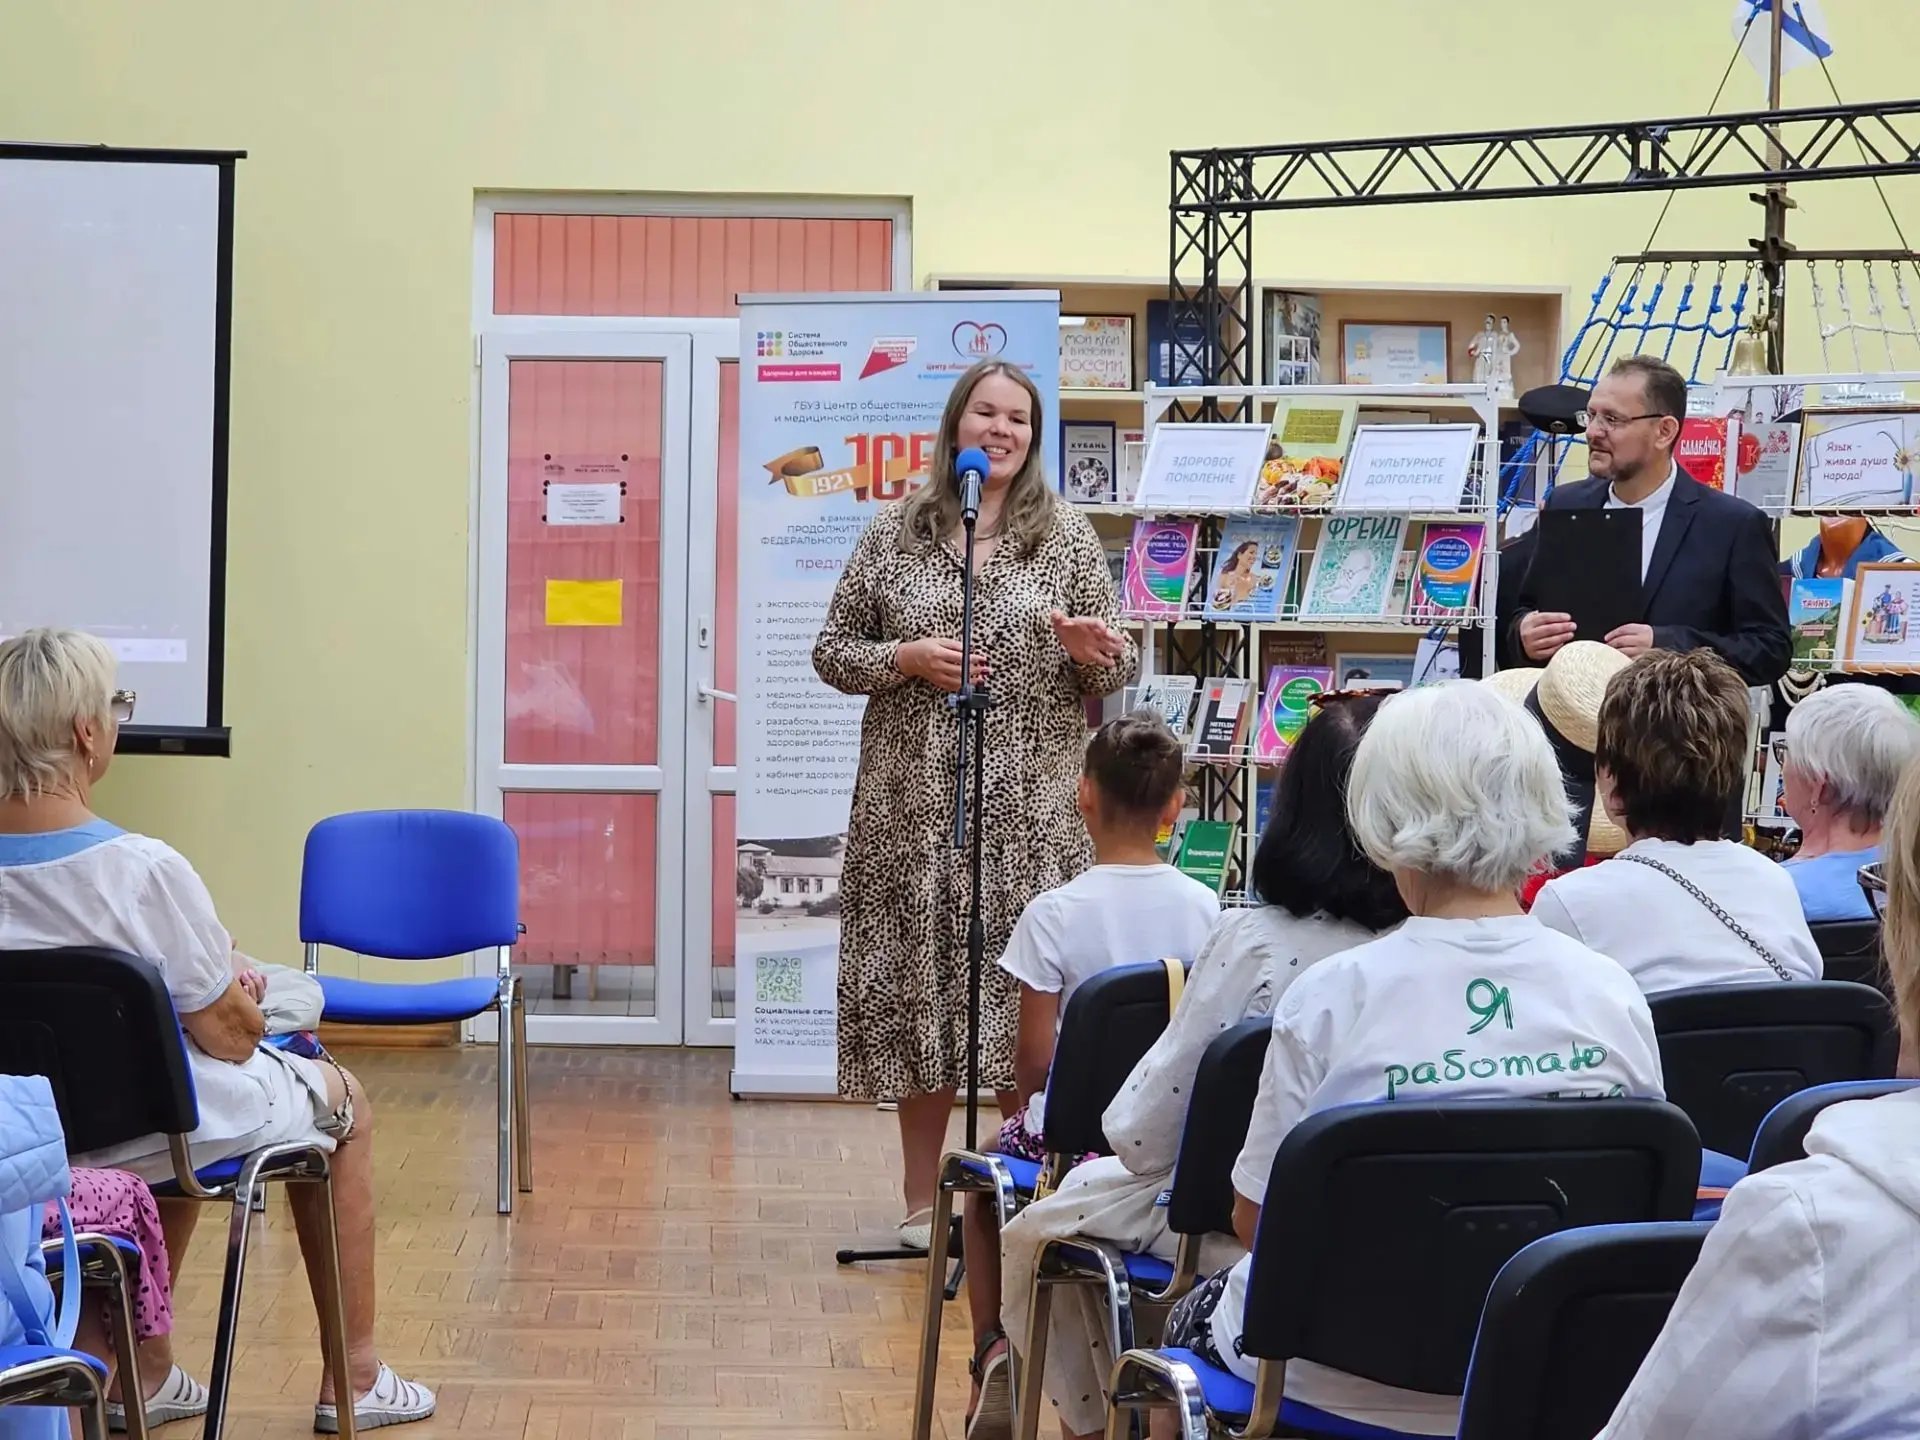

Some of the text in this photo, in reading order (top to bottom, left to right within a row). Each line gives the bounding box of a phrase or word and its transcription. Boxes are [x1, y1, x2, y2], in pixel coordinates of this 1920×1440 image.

[788, 331, 821, 339] Система
[788, 340, 848, 348] Общественного
[788, 348, 824, 357] Здоровья
[794, 401, 821, 410] ГБУЗ
[824, 401, 857, 411] Центр
[774, 415, 782, 423] и
[784, 413, 859, 424] медицинской
[1826, 441, 1852, 452] Язык
[1172, 456, 1236, 468] ЗДОРОВОЕ
[1369, 457, 1446, 468] КУЛЬТУРНОЕ
[1824, 458, 1888, 469] живая душа
[1165, 472, 1237, 484] ПОКОЛЕНИЕ
[1364, 474, 1445, 487] ДОЛГОЛЕТИЕ
[1823, 470, 1863, 483] народа!
[811, 473, 855, 495] 1921
[760, 536, 847, 546] ФЕДЕРАЛЬНОГО
[755, 1006, 810, 1015] Социальные
[1384, 1040, 1608, 1101] работаю
